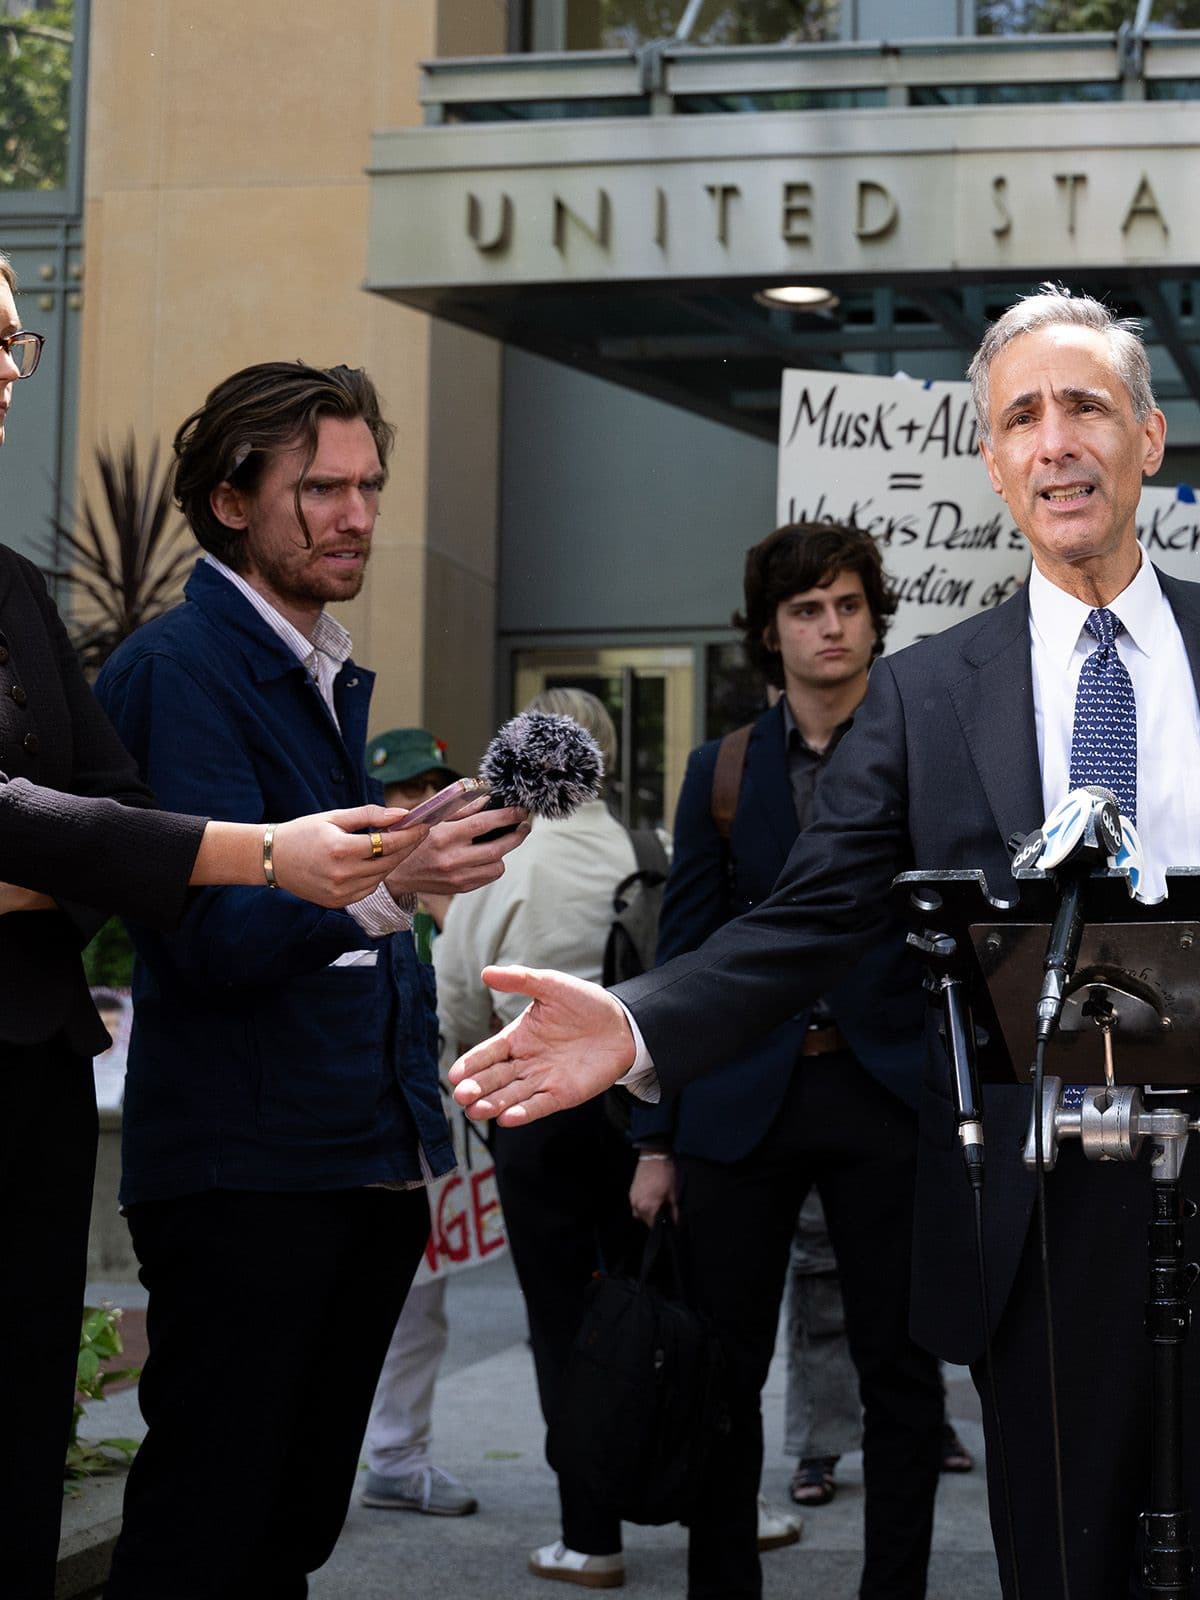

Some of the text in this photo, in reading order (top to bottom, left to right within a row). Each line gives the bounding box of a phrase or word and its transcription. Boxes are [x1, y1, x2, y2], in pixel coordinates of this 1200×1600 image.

[466, 181, 898, 254] UNITED
[924, 501, 1002, 550] Death
[886, 564, 974, 606] uction
[1102, 811, 1122, 847] abc
[1013, 838, 1042, 868] abc
